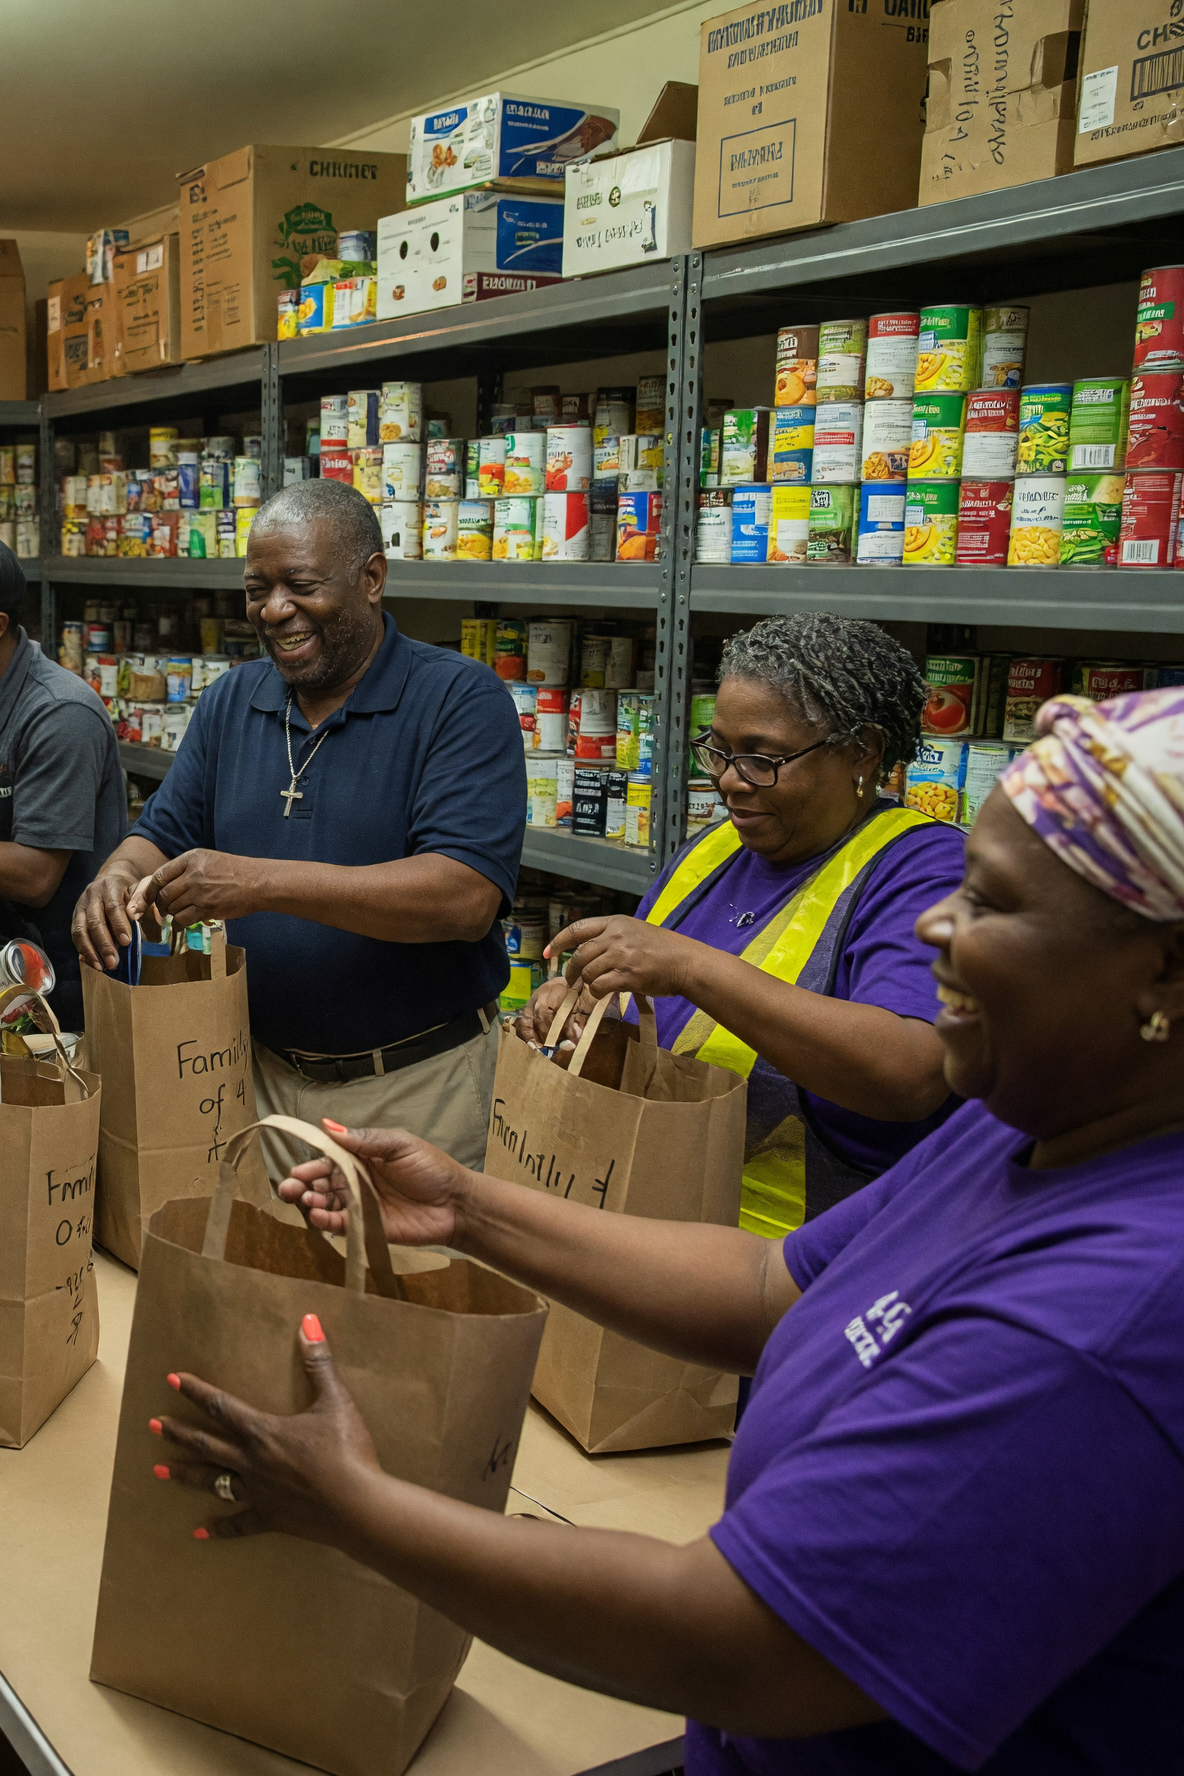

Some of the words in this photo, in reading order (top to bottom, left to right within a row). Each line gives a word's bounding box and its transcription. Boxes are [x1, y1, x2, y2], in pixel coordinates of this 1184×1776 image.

[177, 1029, 248, 1079] Family
[199, 1083, 226, 1135] of
[236, 1078, 246, 1106] 4
